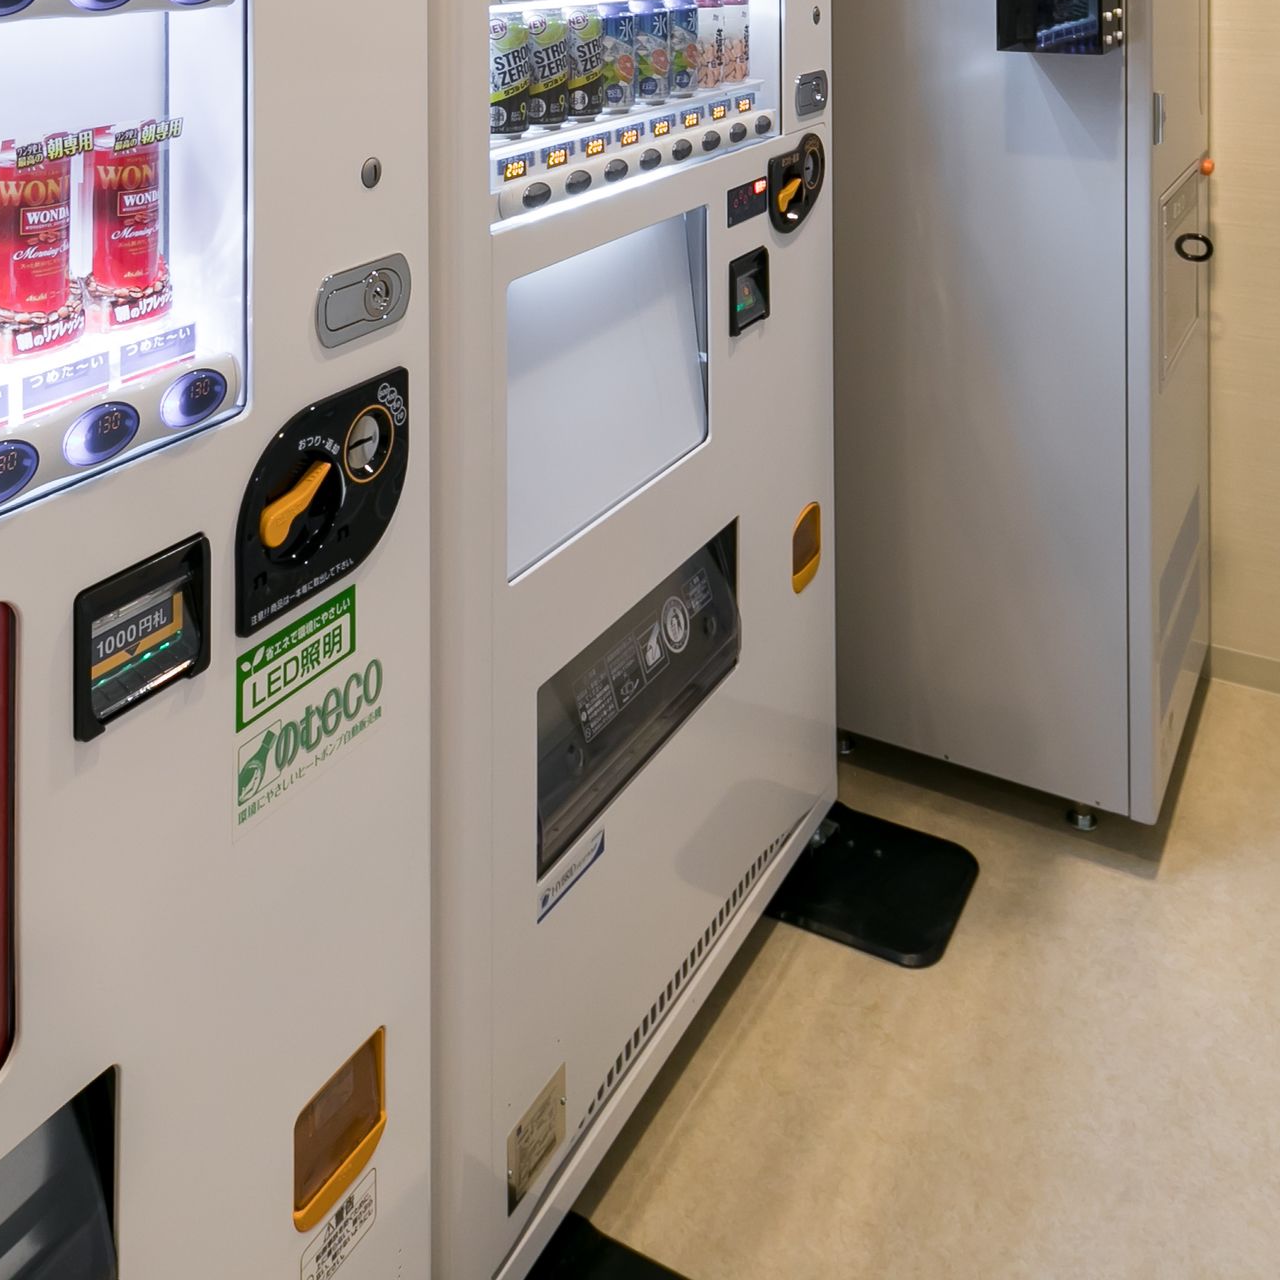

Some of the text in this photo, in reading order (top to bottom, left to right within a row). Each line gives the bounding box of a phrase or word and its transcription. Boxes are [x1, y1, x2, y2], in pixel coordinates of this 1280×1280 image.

[47, 131, 94, 160] 朝専用
[140, 119, 182, 145] 朝専用
[96, 611, 168, 659] 1000円札
[252, 623, 343, 709] LED照明
